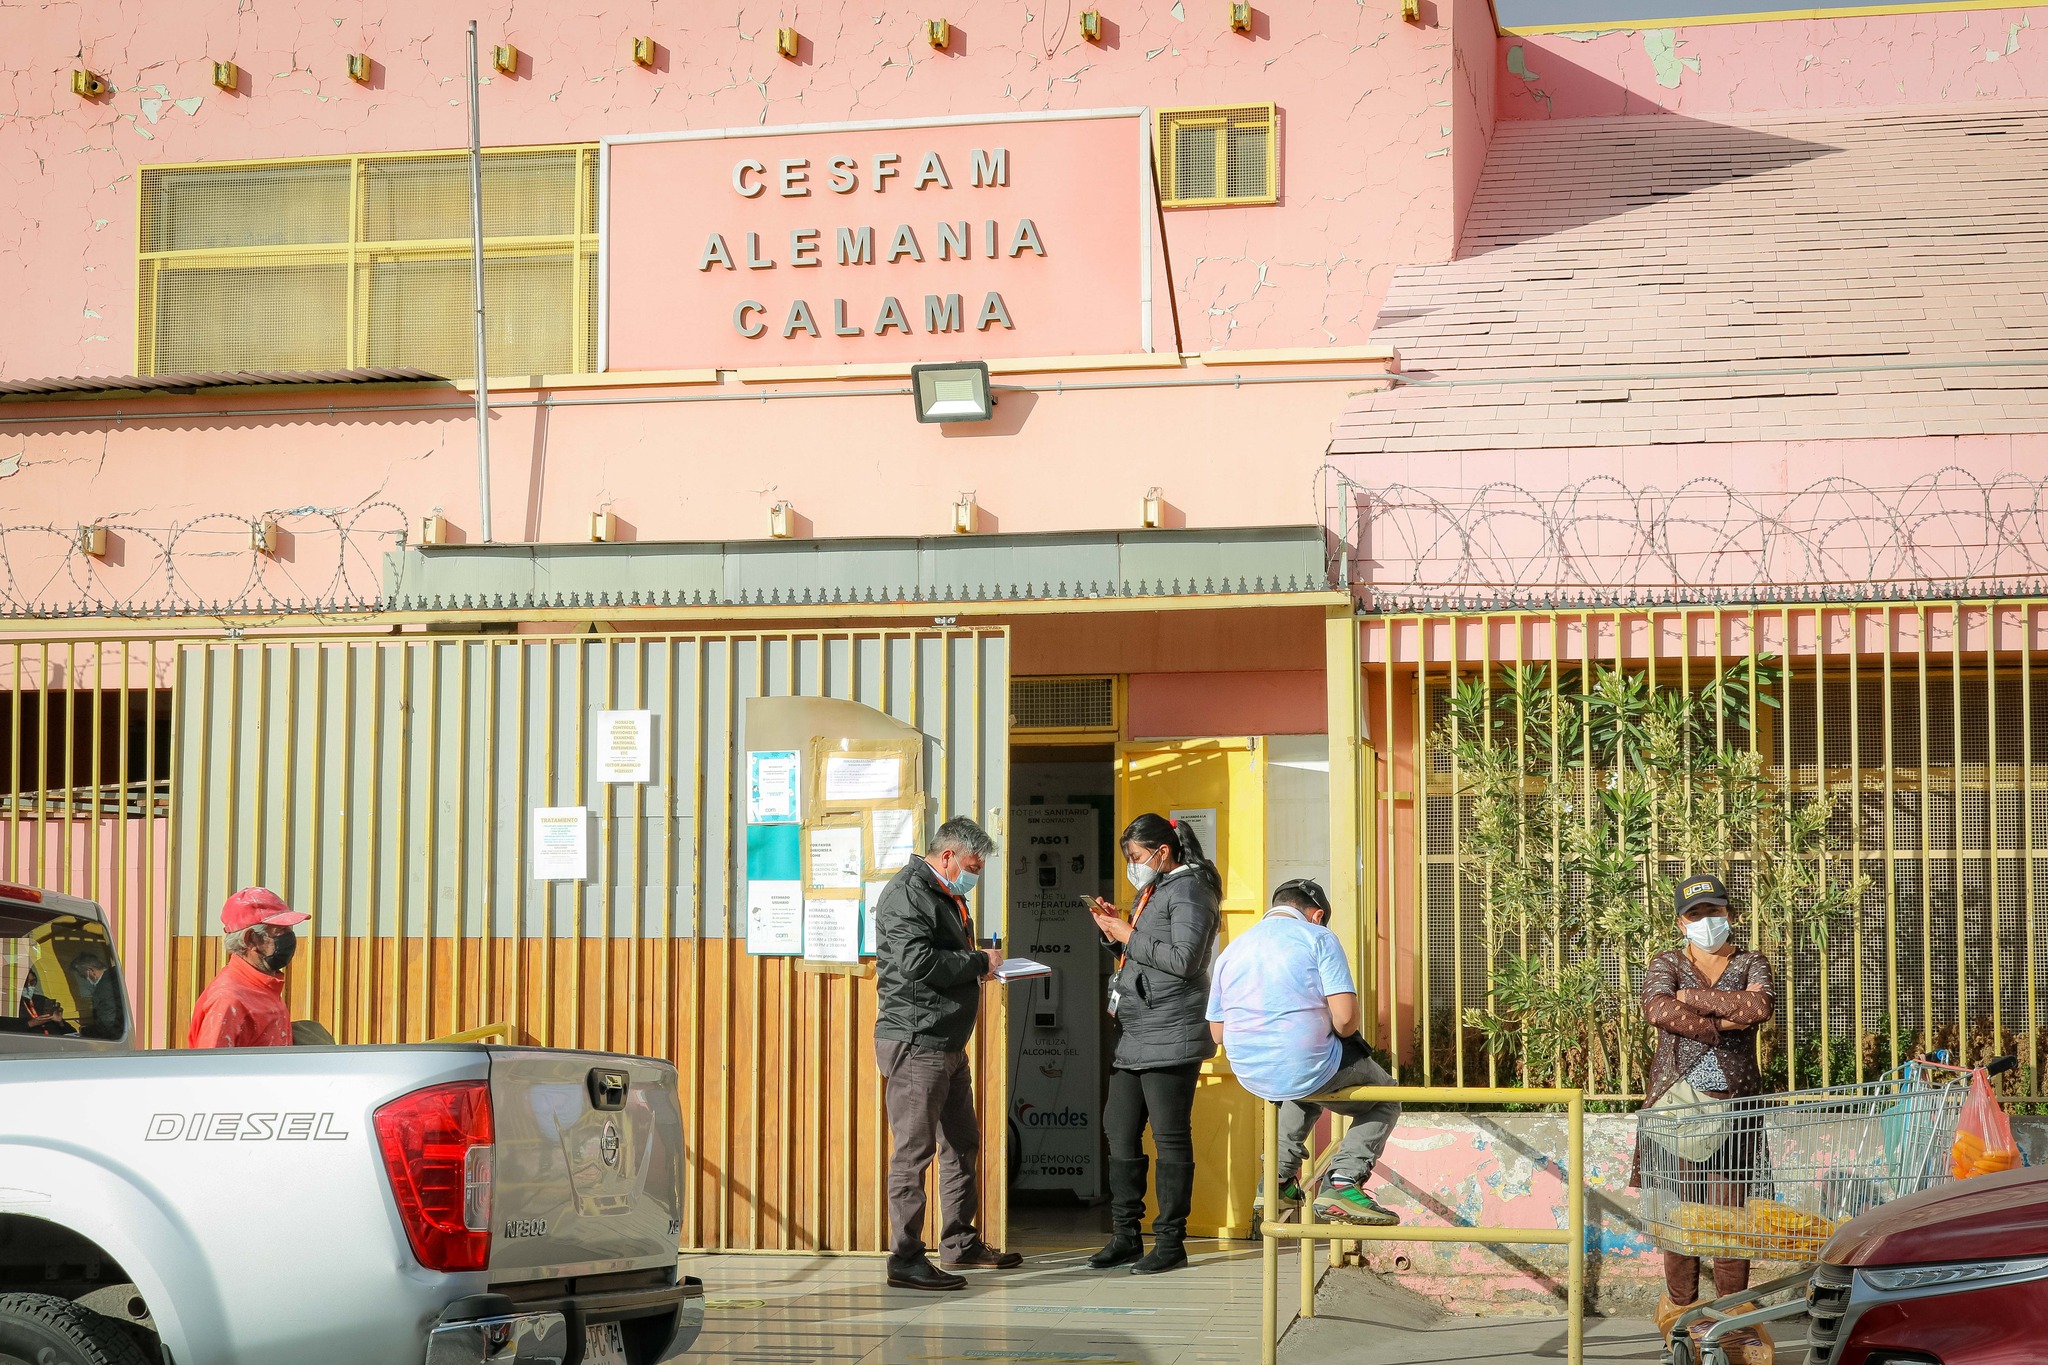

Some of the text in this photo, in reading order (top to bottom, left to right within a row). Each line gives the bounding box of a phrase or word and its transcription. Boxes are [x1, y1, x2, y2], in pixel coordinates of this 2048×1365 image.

[732, 147, 1010, 198] CESFAM
[699, 218, 1048, 271] ALEMANIA
[733, 291, 1016, 339] CALAMA
[1044, 808, 1089, 816] SANITARIO
[1030, 836, 1069, 845] PASO 1
[1685, 883, 1712, 897] JCB
[1016, 901, 1085, 909] TEMPERATURA
[1030, 944, 1071, 954] PASO 2
[1035, 1038, 1067, 1047] UTILIZA
[1022, 1048, 1080, 1056] ALCOHOL GEL
[145, 1112, 350, 1142] DIESEL
[1020, 1152, 1091, 1164] UIDÉMONOS
[1041, 1166, 1084, 1176] TODOS
[504, 1217, 549, 1239] NP300
